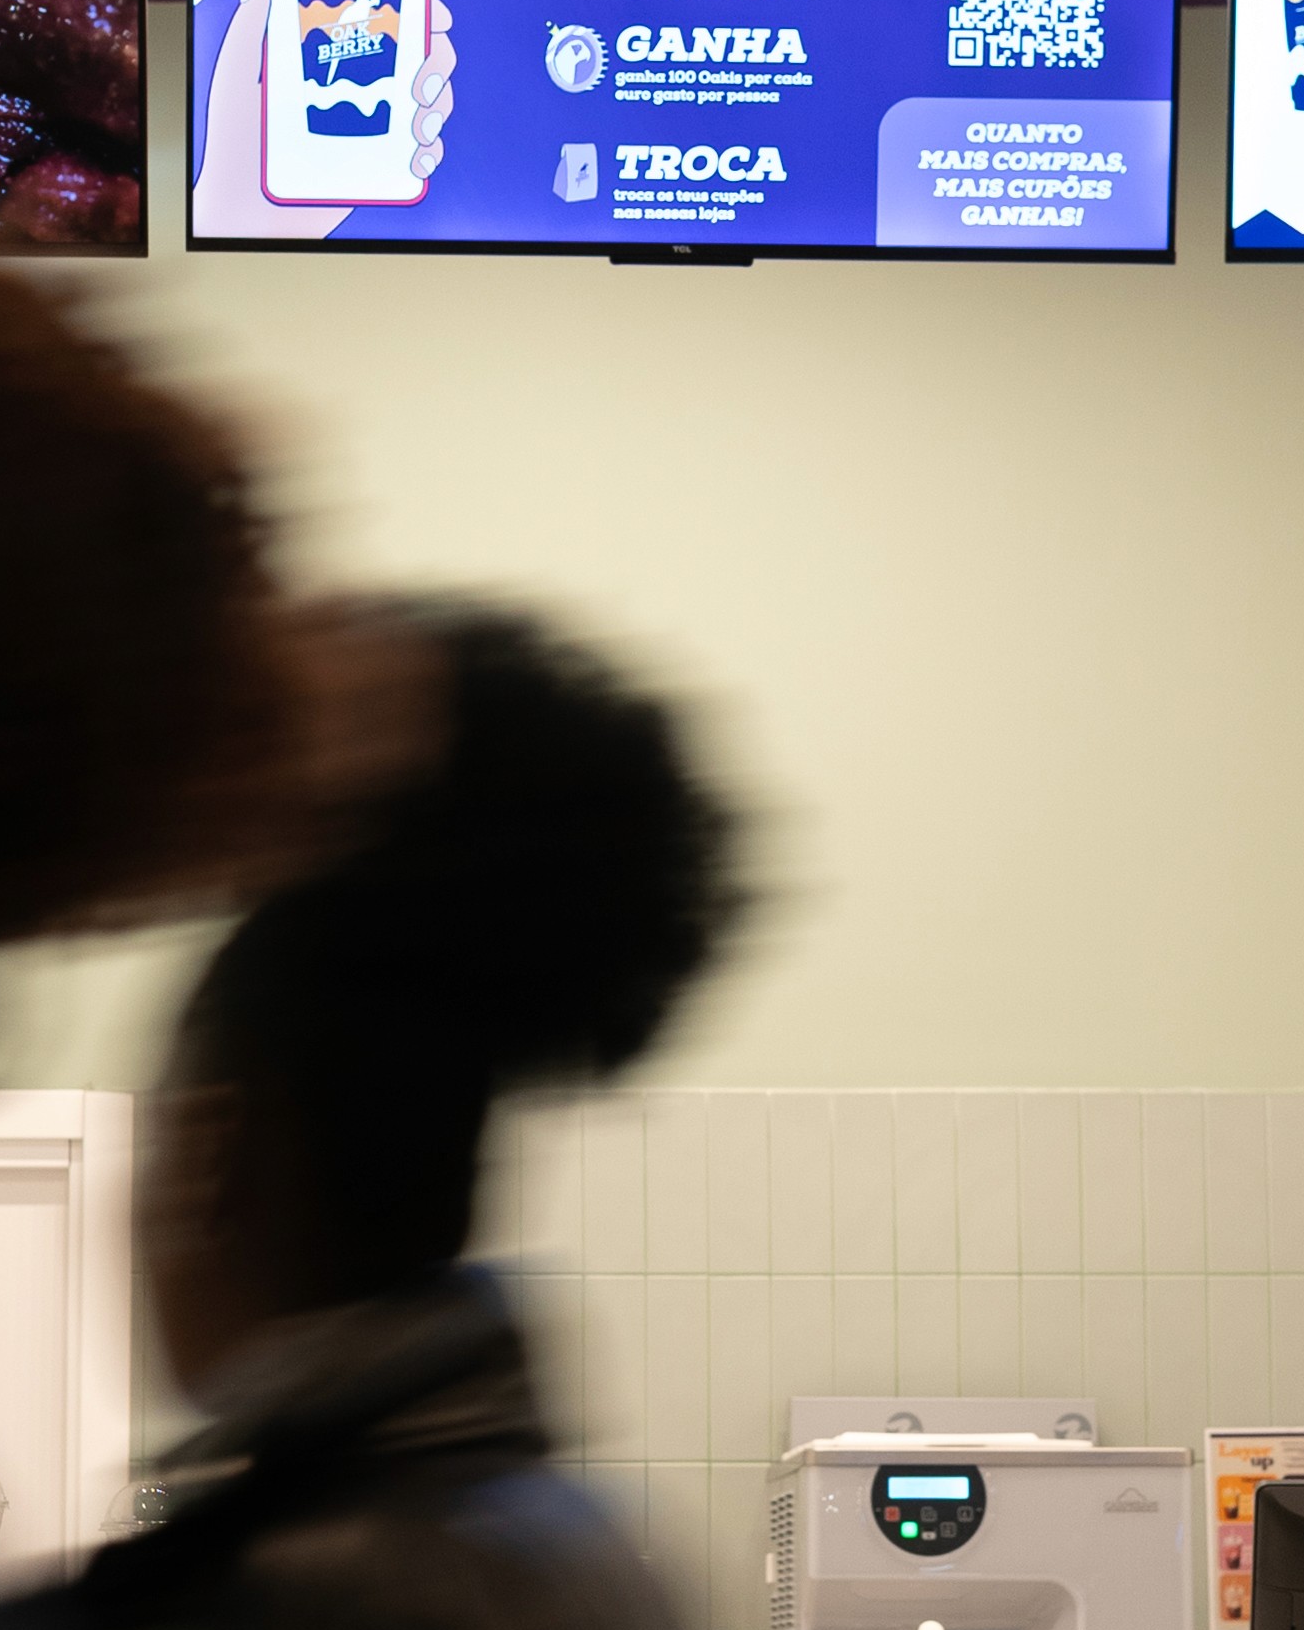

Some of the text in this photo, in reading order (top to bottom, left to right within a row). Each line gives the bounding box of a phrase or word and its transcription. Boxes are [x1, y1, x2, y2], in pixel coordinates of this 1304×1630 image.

[331, 21, 370, 42] OAK
[318, 33, 384, 60] BERRY
[616, 26, 807, 63] GANHA
[615, 70, 812, 87] ganha 100 Oakis por cada
[615, 89, 780, 105] euro gasto por pessoa
[966, 122, 1083, 144] QUANTO
[616, 145, 787, 181] TROCA
[918, 150, 1127, 174] MAIS COMPRAS,
[613, 189, 764, 205] troca os teus cupões
[933, 175, 1112, 200] MAIS CUPÕES
[613, 206, 736, 223] nas nossas lojas
[961, 205, 1084, 226] GANHAS!
[672, 245, 692, 254] TCL
